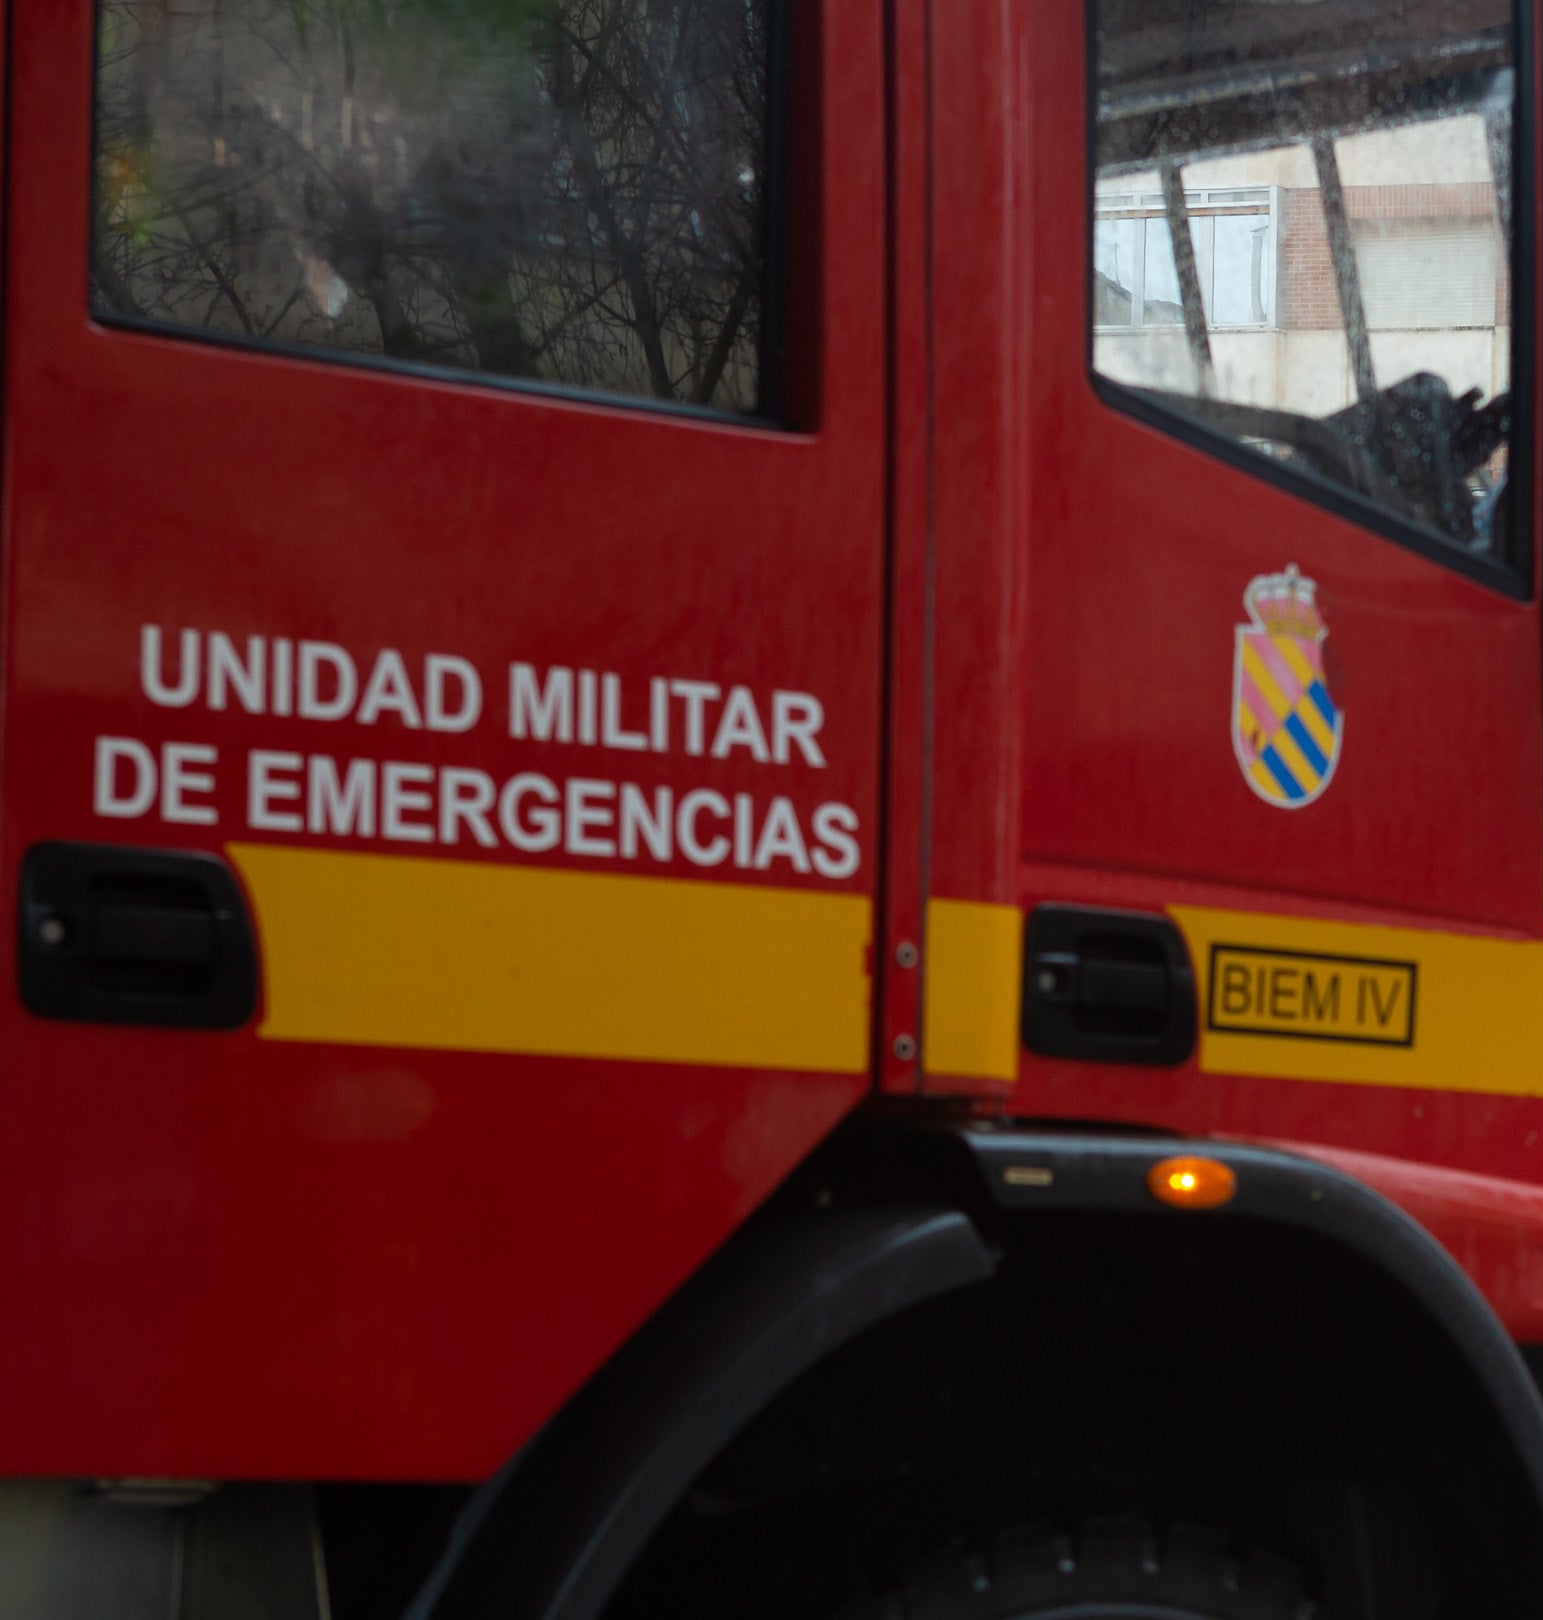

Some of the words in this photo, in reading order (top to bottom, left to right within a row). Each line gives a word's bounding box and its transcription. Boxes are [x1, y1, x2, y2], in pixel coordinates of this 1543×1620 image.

[140, 624, 483, 733] UNIDAD
[507, 660, 828, 768] MILITAR
[92, 735, 220, 827] DE
[246, 748, 861, 880] EMERGENCIAS
[1222, 963, 1342, 1023] BIEM
[1356, 976, 1402, 1028] IV
